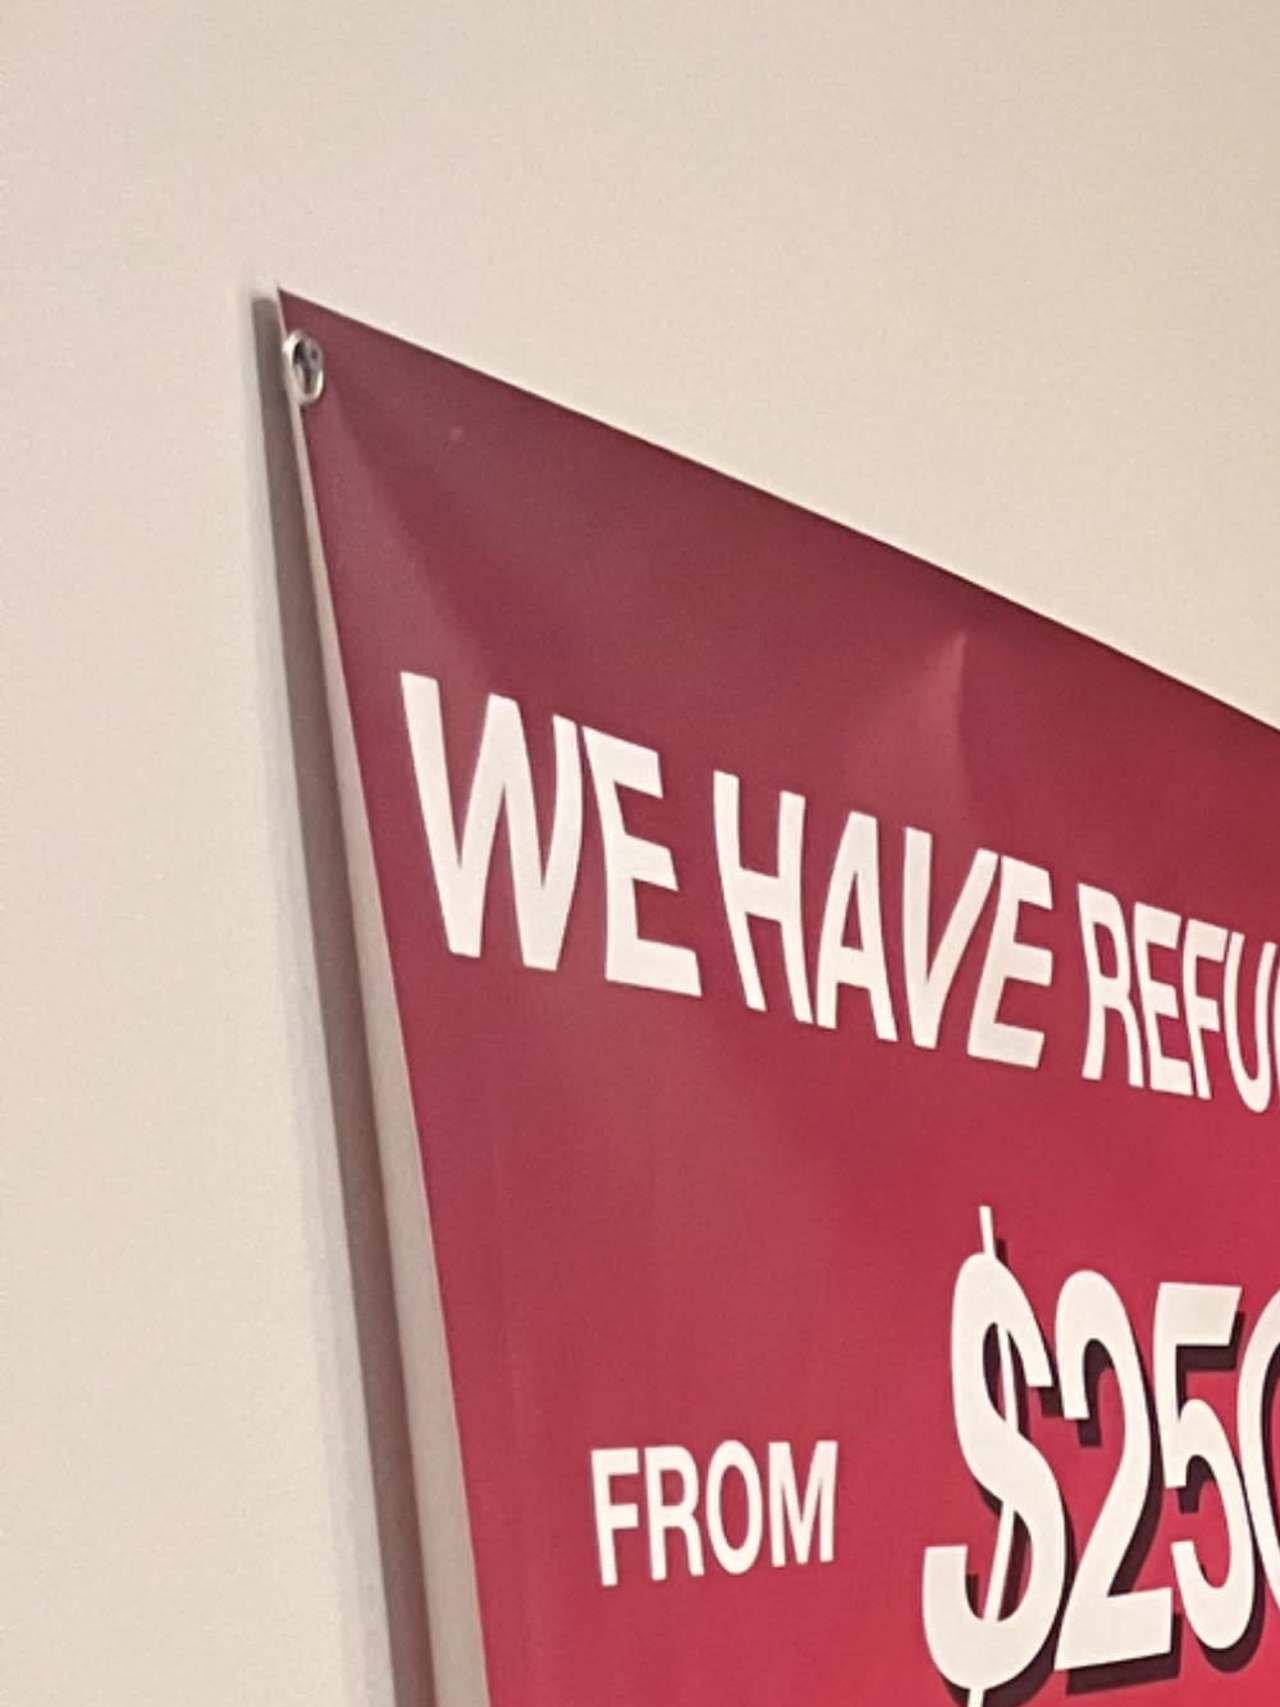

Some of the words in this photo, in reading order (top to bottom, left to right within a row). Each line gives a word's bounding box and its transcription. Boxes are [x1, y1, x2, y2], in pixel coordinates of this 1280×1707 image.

[399, 671, 702, 997] WE
[713, 770, 1053, 1068] HAVE
[591, 1440, 838, 1587] FROM
